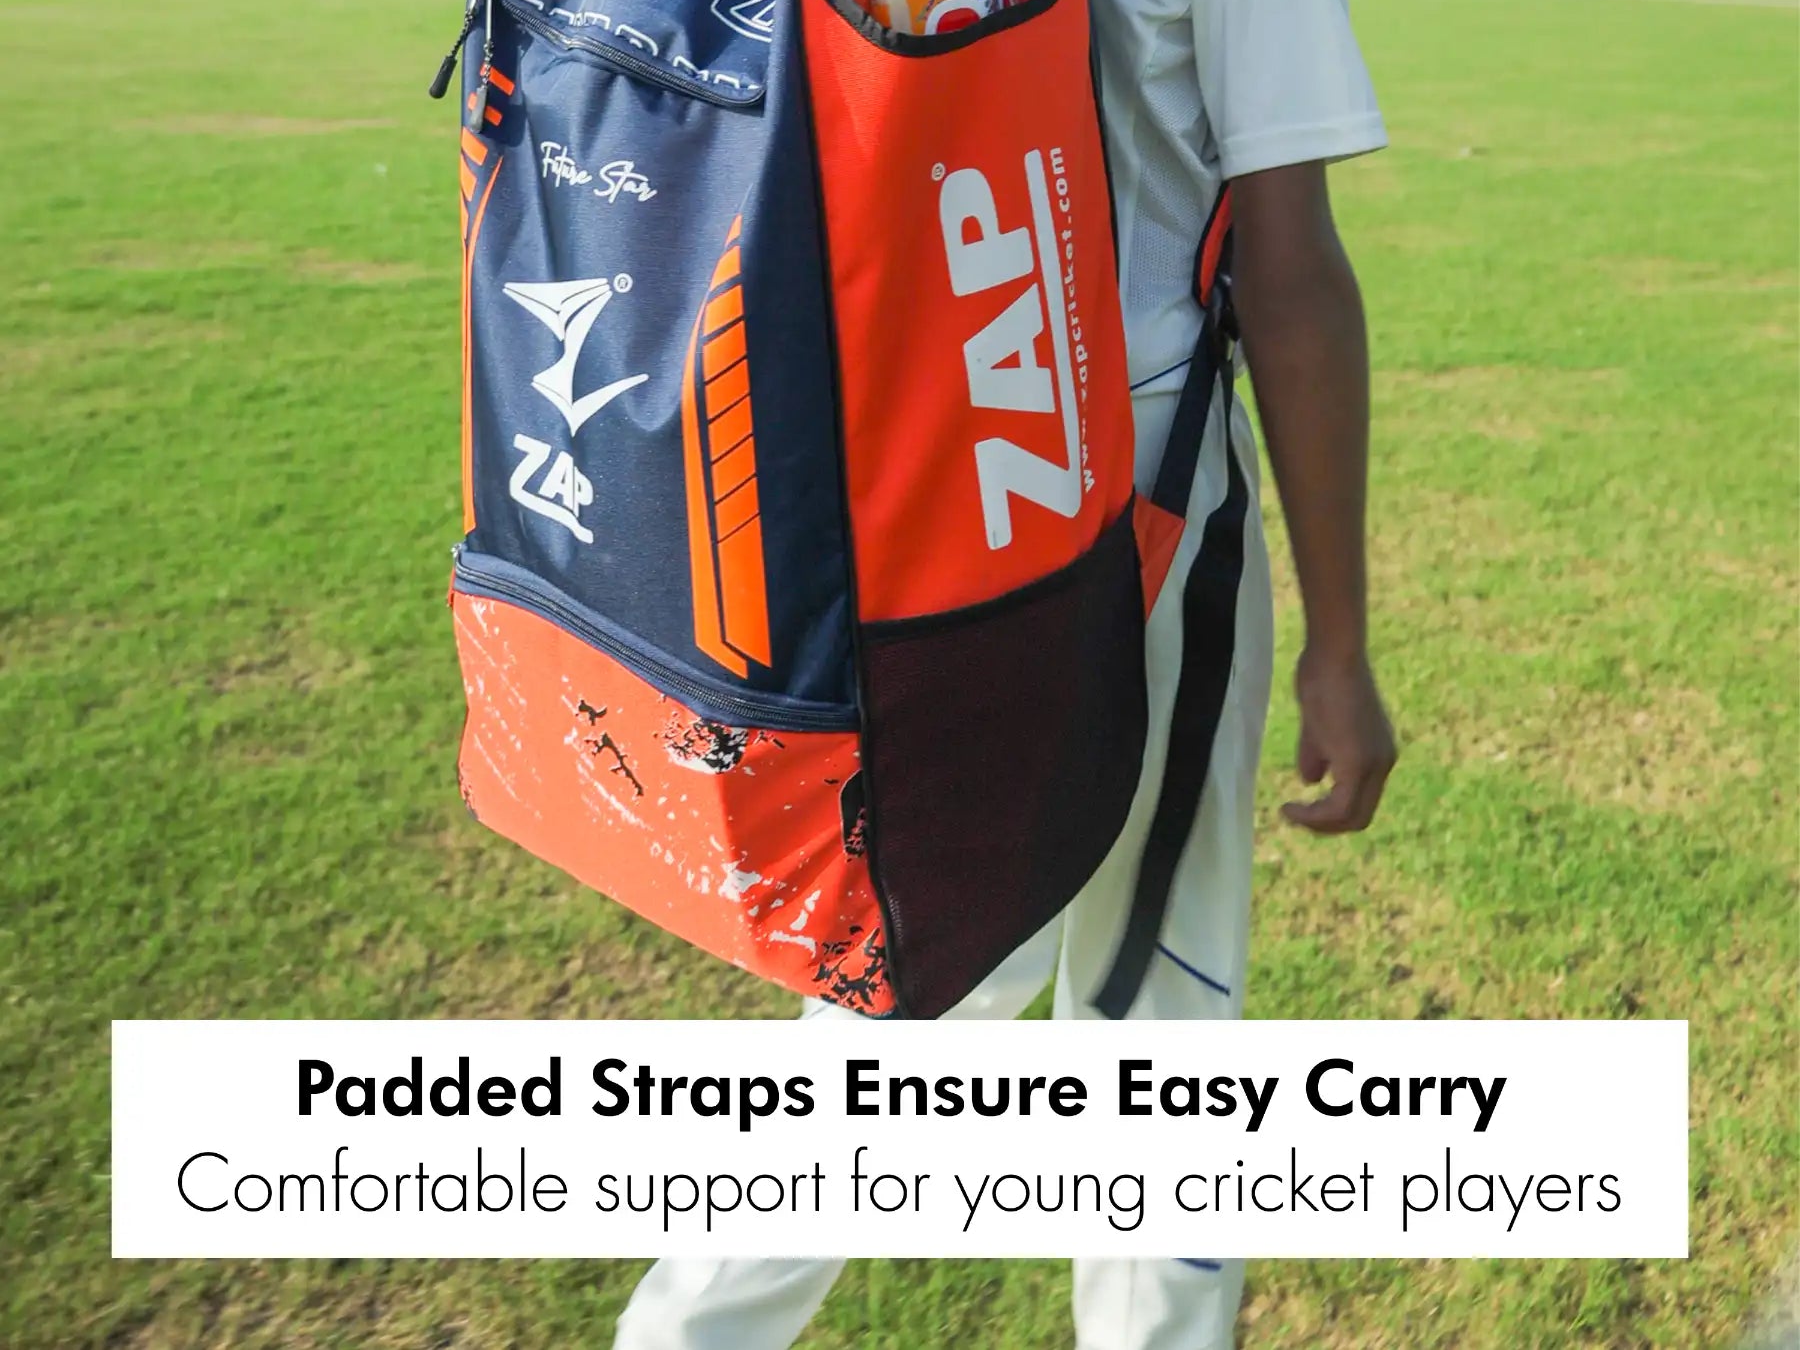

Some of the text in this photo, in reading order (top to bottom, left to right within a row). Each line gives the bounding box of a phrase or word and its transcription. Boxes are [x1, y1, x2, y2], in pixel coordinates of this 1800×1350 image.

[540, 141, 658, 204] Future Star
[939, 148, 1082, 550] ZAP
[509, 433, 594, 544] ZAP
